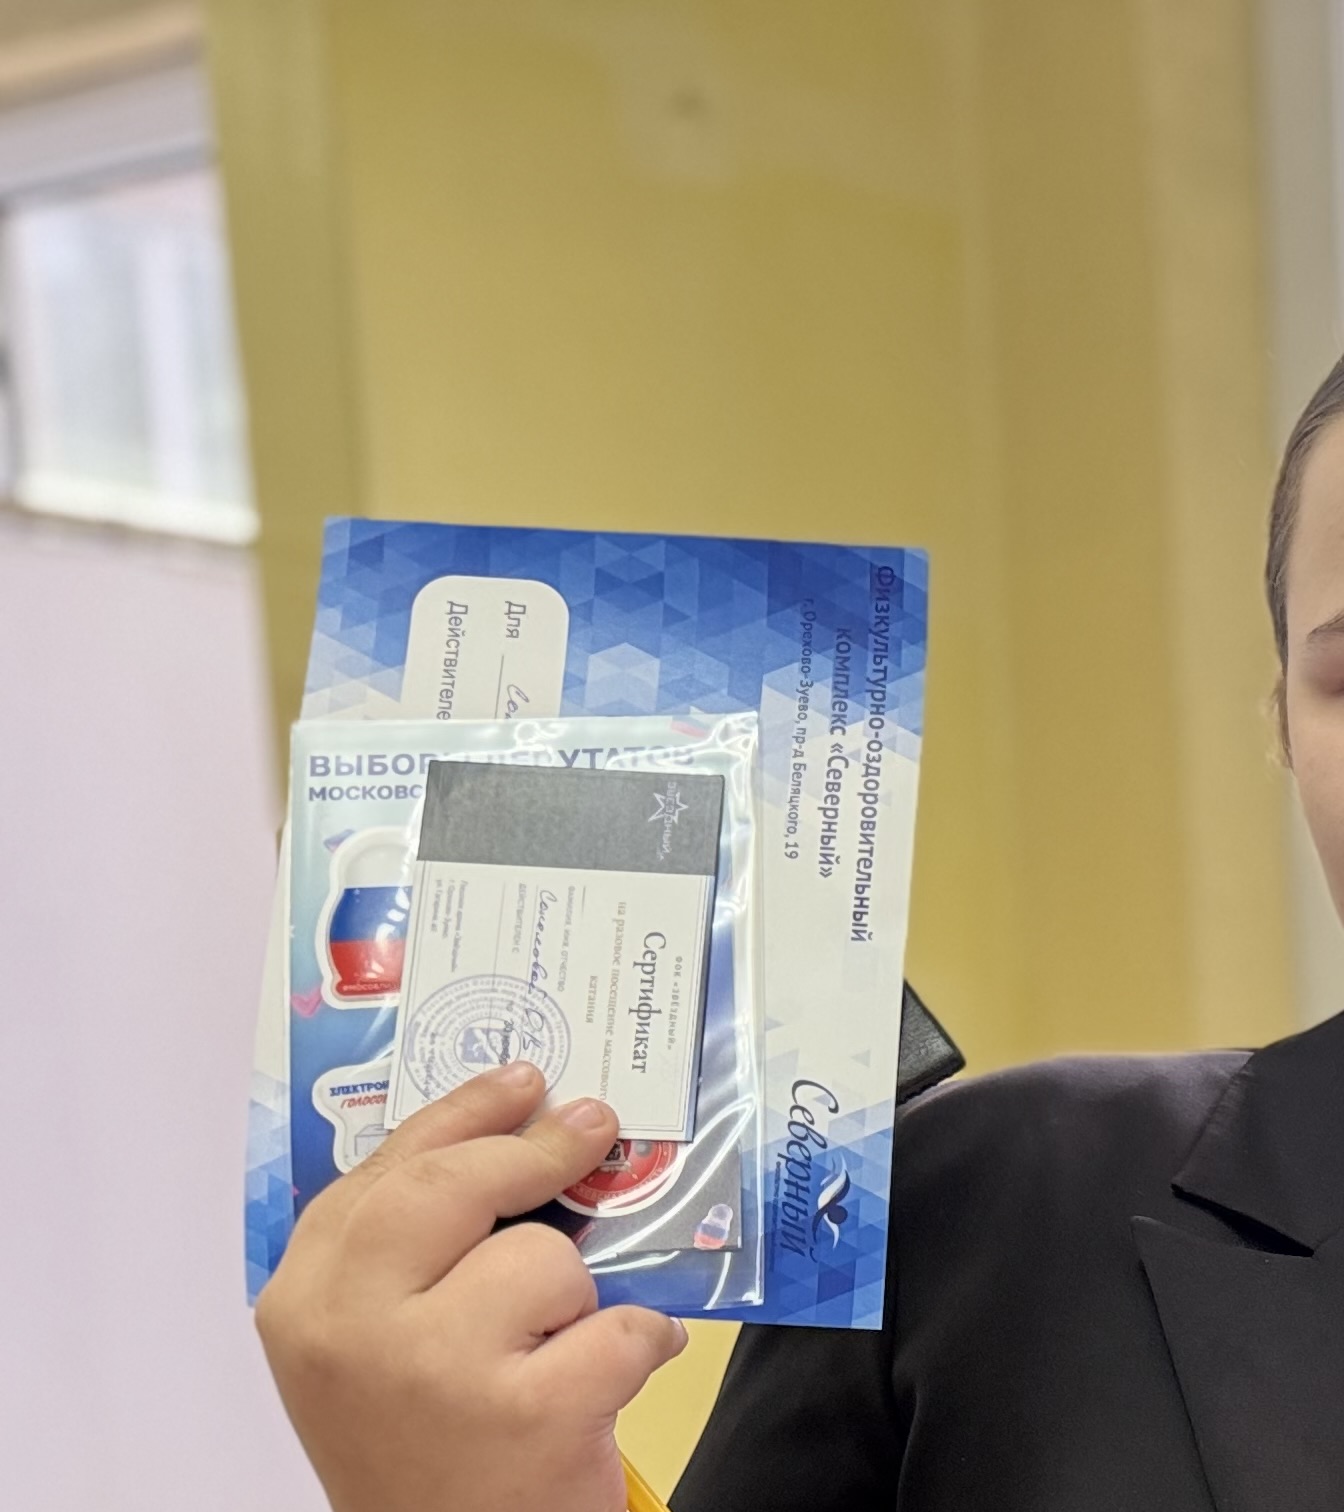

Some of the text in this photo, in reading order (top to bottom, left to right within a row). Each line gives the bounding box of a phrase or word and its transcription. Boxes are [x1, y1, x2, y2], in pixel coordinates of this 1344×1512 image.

[436, 601, 469, 721] Действителе
[504, 601, 527, 639] Для
[793, 610, 817, 724] Орехово-Зуево,
[308, 785, 423, 801] МОСКОВС
[309, 751, 438, 777] ВЫБОР
[817, 628, 851, 879] комплекс «Северный»
[851, 566, 897, 942] Физкультурно-оздоровительный
[784, 841, 799, 860] 19
[585, 975, 598, 1024] катания
[599, 901, 627, 1101] на разовое посещение массового
[628, 931, 667, 1074] Сертификат
[777, 1079, 840, 1264] Северный
